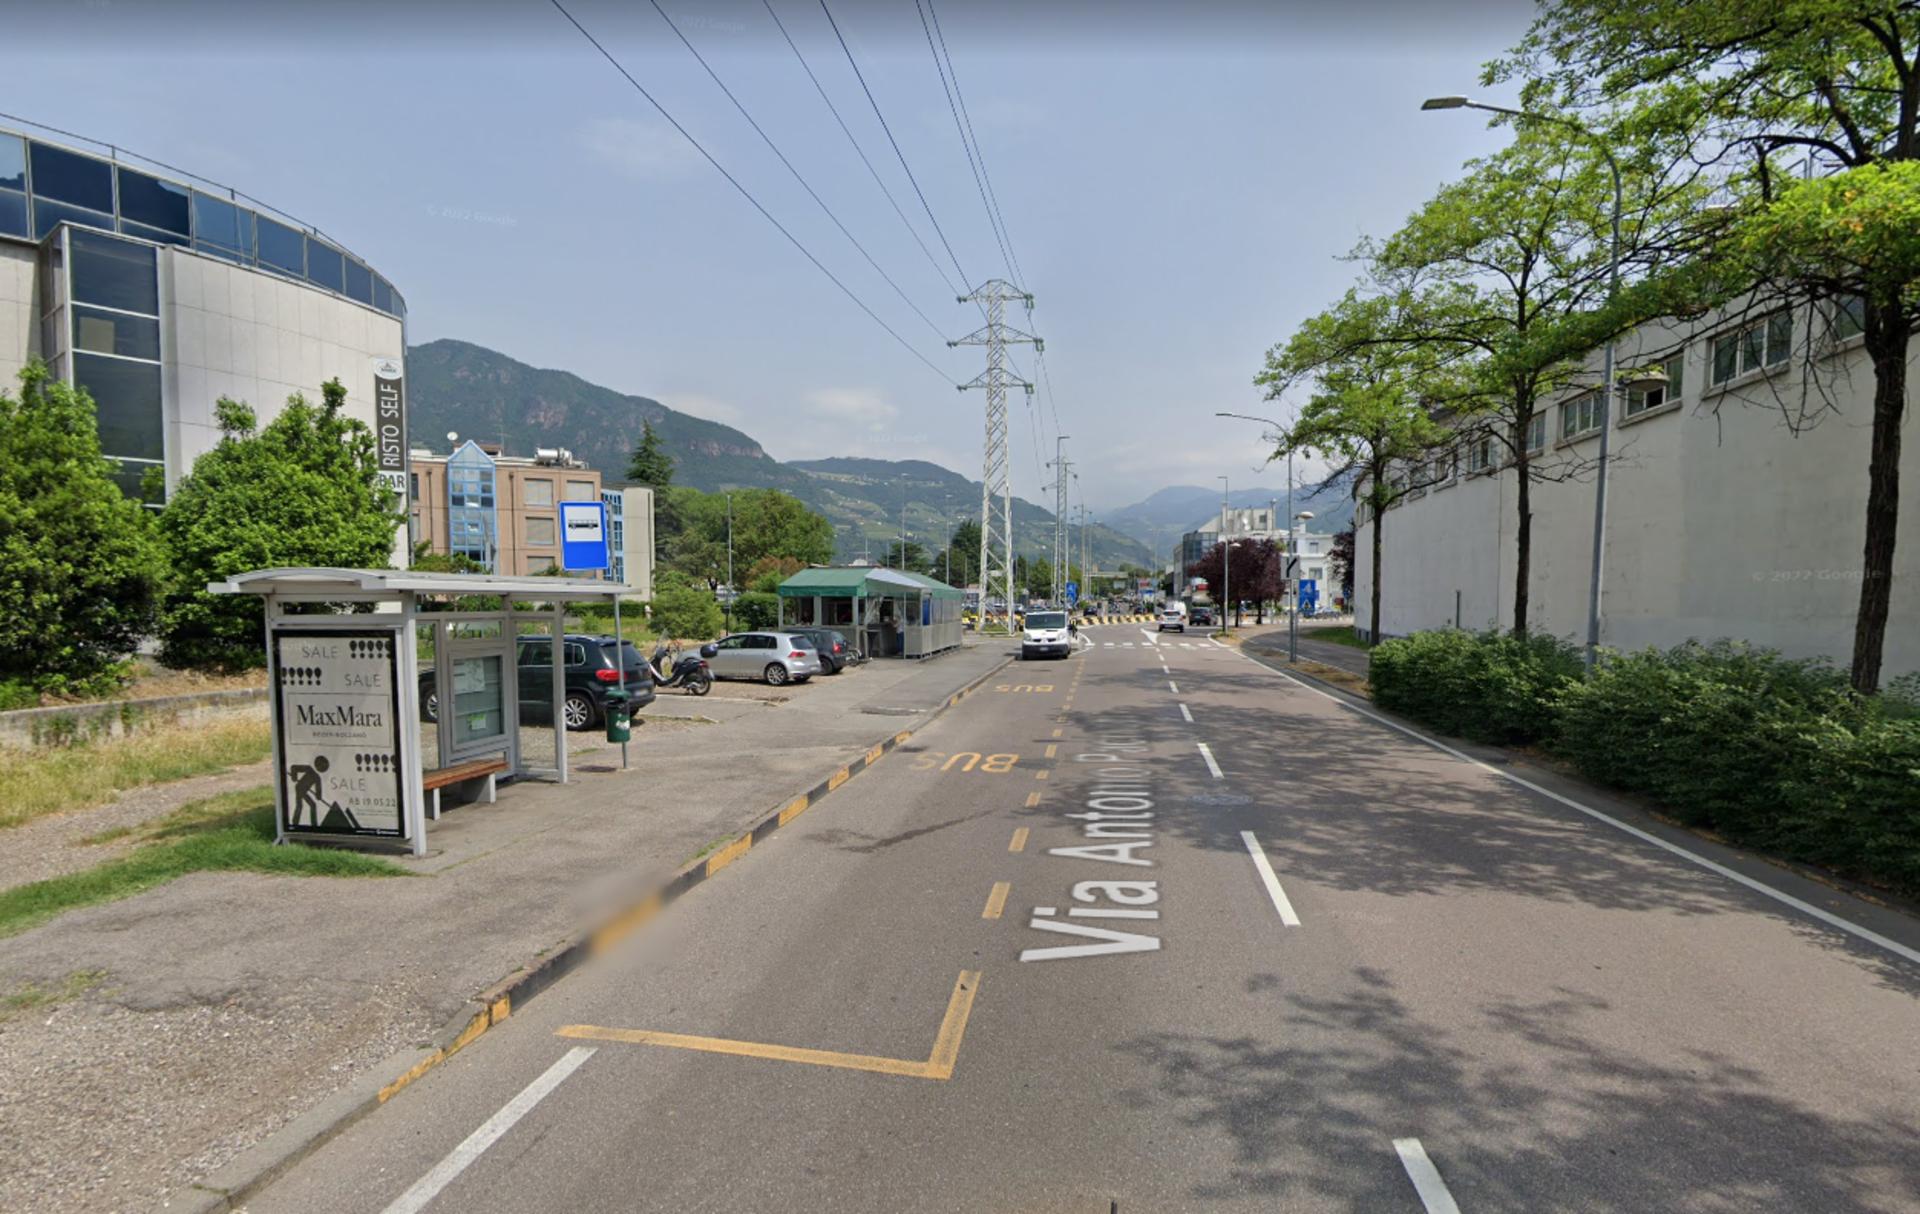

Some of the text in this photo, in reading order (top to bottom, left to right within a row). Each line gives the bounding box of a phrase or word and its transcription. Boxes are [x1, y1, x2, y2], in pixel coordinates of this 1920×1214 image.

[380, 383, 399, 418] SELF
[382, 424, 400, 467] RISTO
[379, 474, 405, 489] BAR
[302, 646, 339, 659] SALE
[344, 674, 382, 688] SALE
[993, 684, 1055, 693] BUS
[296, 704, 383, 728] MaxMara
[910, 752, 1020, 773] BUS
[330, 777, 367, 792] SALE
